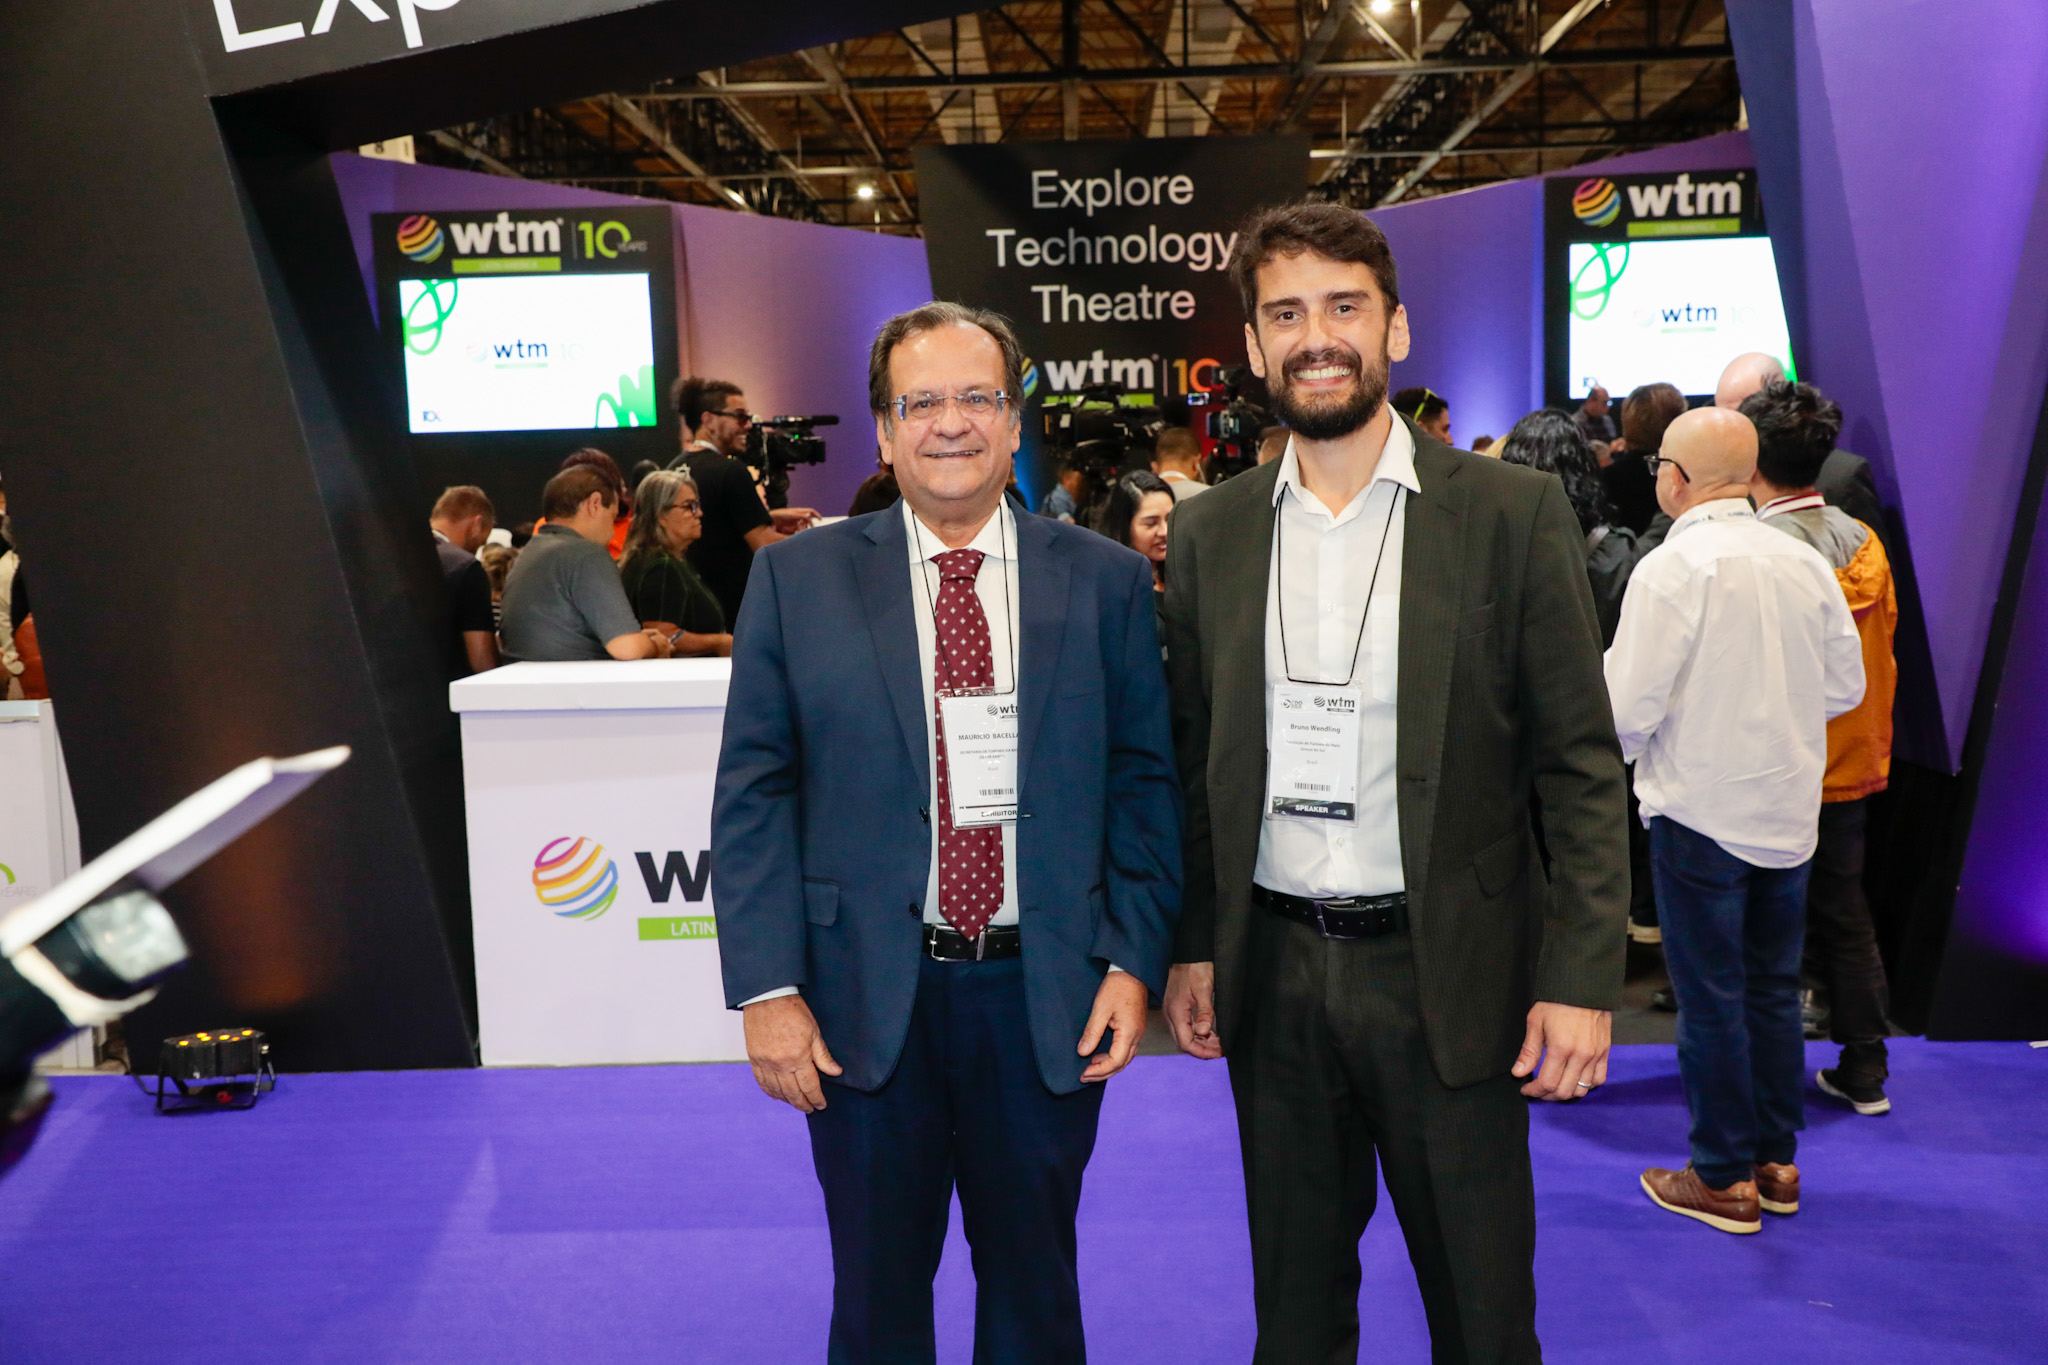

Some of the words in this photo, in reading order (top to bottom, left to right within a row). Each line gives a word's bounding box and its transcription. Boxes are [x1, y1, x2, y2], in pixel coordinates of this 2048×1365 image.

[1031, 168, 1195, 217] Explore
[1627, 173, 1742, 217] wtm
[449, 211, 562, 254] wtm
[577, 220, 631, 259] 10
[985, 224, 1239, 271] Technology
[1030, 284, 1196, 324] Theatre
[1661, 303, 1717, 323] wtm
[493, 339, 548, 359] wtm
[1044, 349, 1156, 391] wtm
[1327, 696, 1355, 708] wtm
[1310, 725, 1340, 734] Wendling
[1295, 804, 1329, 814] SPEAKER
[671, 920, 716, 937] LATIN
